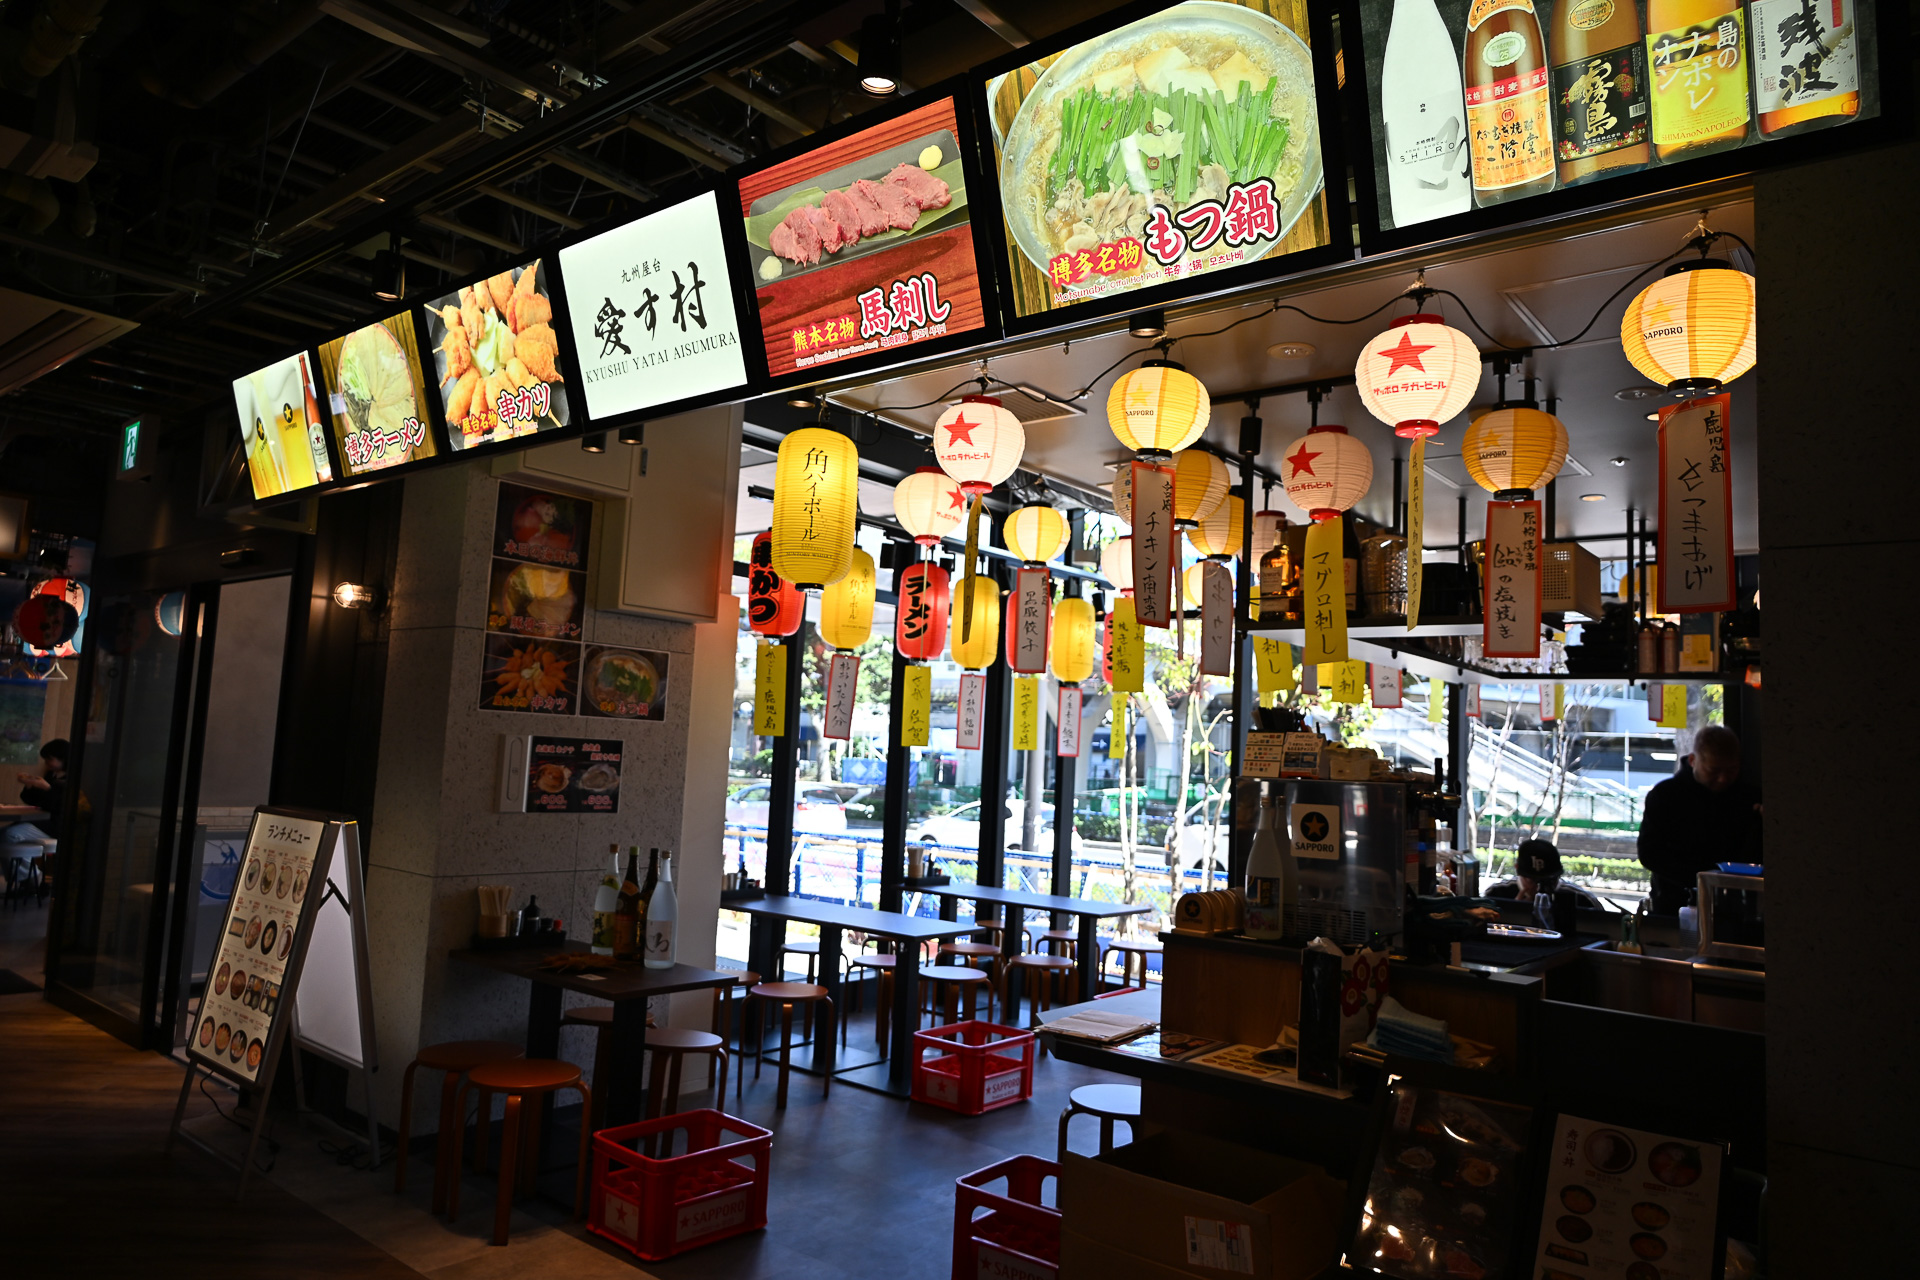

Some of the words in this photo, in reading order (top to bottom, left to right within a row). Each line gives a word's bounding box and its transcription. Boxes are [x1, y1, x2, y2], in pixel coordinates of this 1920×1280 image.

[1716, 21, 1738, 69] 島の
[1777, 0, 1838, 107] 残波
[1560, 59, 1618, 140] 霧島
[1399, 142, 1455, 163] SHIRO
[1144, 176, 1281, 266] もつ鍋
[621, 258, 661, 283] 九州屋台
[1048, 236, 1143, 288] 博多名物
[1164, 260, 1203, 277] 牛杂火锅
[595, 261, 708, 359] 愛す村
[858, 272, 952, 339] 馬刺し
[1054, 284, 1107, 303] Motsunabe
[792, 314, 855, 355] 熊本名物
[1643, 326, 1683, 341] SAPPORO
[586, 360, 629, 383] KYUSHU
[632, 349, 669, 370] YATAI
[674, 331, 737, 360] AISUMURA
[497, 382, 552, 428] 串カツ
[1373, 381, 1447, 396] サッポロラガービール
[345, 417, 426, 466] 博多ラーメン
[461, 408, 498, 435] 屋台名物
[1704, 410, 1726, 474] 鹿児島
[1478, 450, 1507, 460] SAPPORO
[801, 447, 829, 542] 角ハイボール
[1677, 458, 1713, 591] さつまあげ
[1143, 511, 1160, 619] チキン南蛮
[904, 575, 931, 640] ラーメン
[1022, 591, 1039, 652] 黒豚餃子
[1312, 551, 1337, 655] マグロ刺し
[1262, 637, 1281, 674] 刺し
[531, 694, 568, 711] 串カツ
[617, 700, 649, 717] もつ鍋
[267, 824, 311, 844] ランチメニュー
[1295, 841, 1335, 853] SAPPORO
[992, 1077, 1020, 1094] SAPPORO
[693, 1200, 745, 1226] SAPPORO
[994, 1261, 1044, 1280] SAPPO
